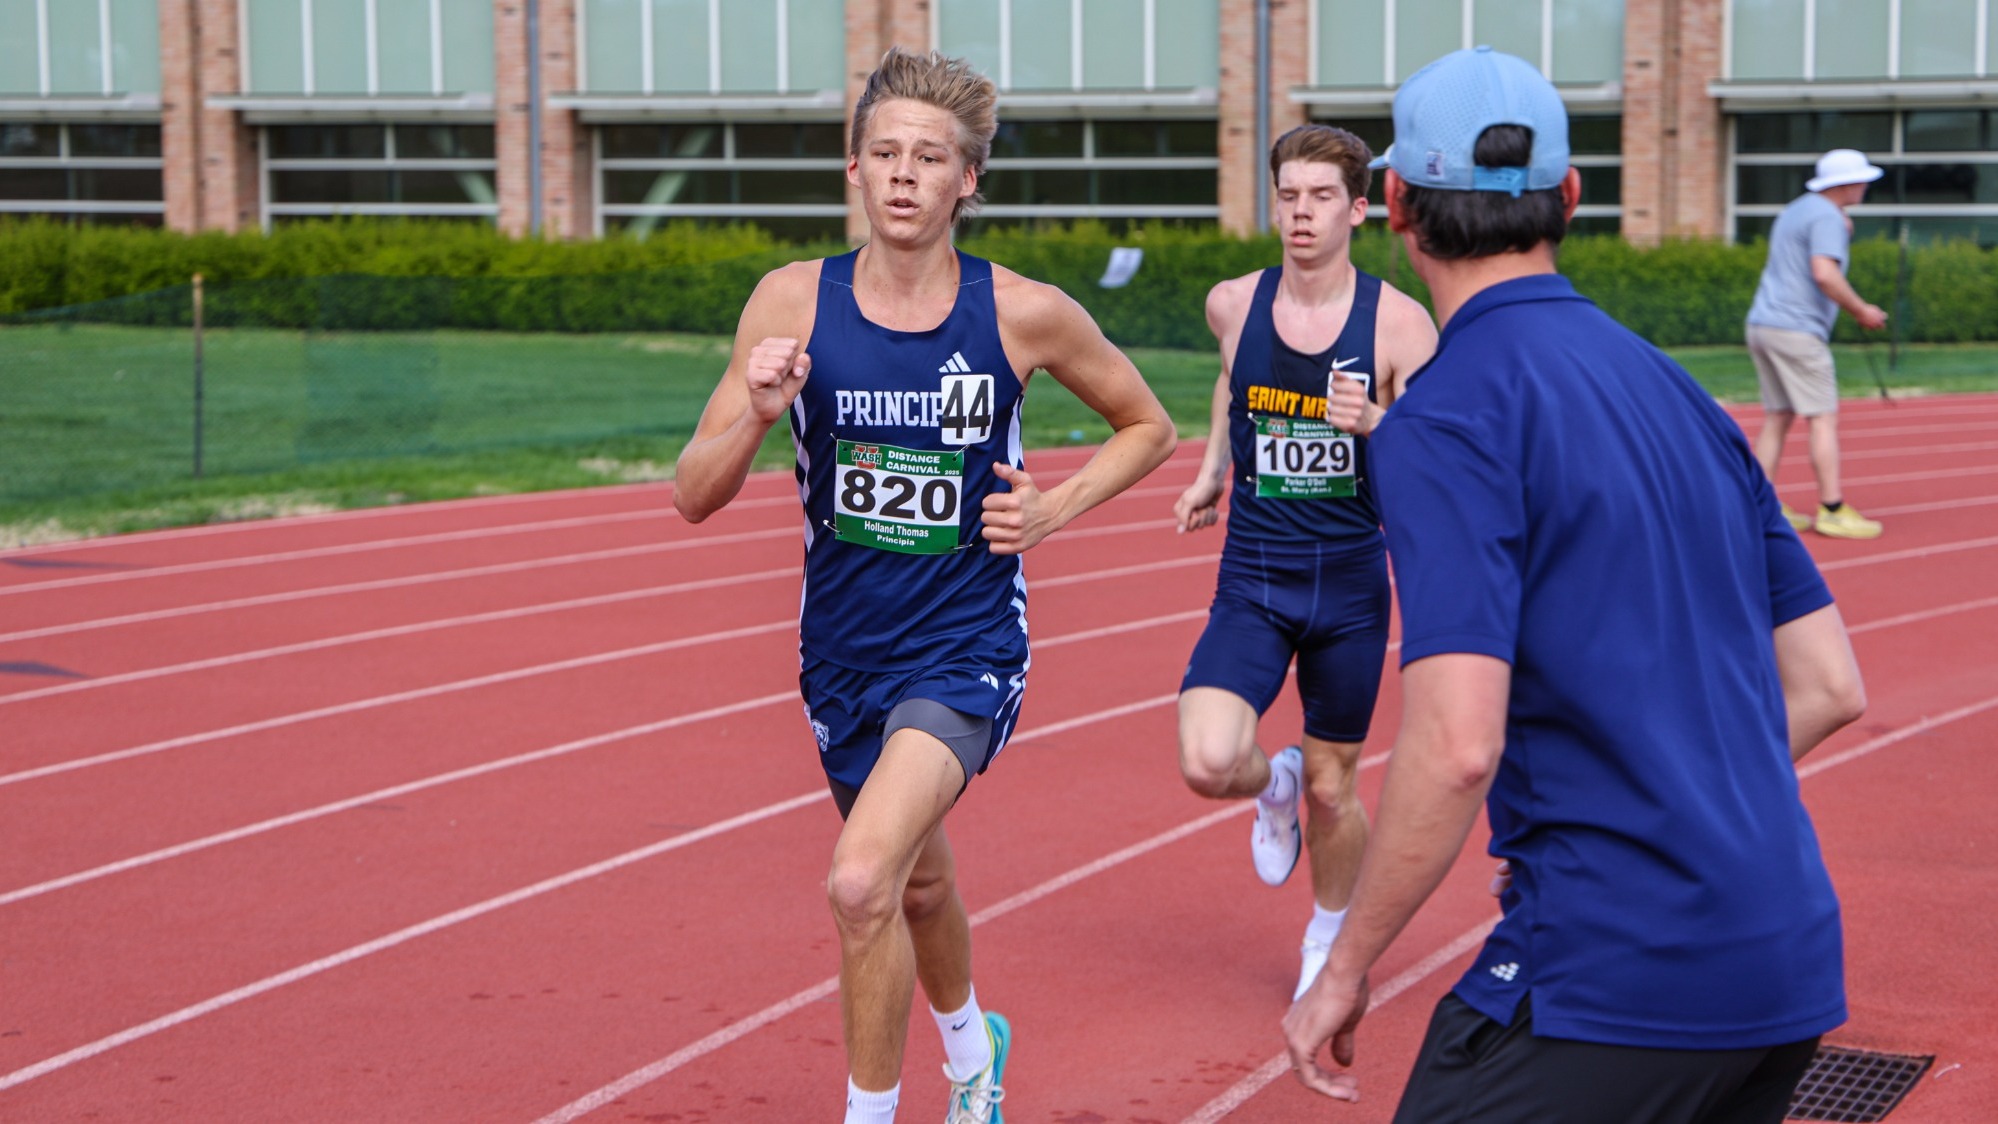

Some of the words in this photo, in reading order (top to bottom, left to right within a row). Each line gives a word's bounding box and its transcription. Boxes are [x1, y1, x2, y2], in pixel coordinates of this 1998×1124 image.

[835, 390, 943, 427] PRINCIP
[942, 379, 991, 439] 44
[1248, 385, 1301, 416] SAINT
[1301, 394, 1328, 418] MA
[1292, 430, 1335, 438] CARNIVAL
[851, 450, 882, 465] WASH
[888, 450, 941, 464] DISTANCE
[1263, 439, 1350, 473] 1029
[886, 461, 940, 474] CARNIVAL
[840, 469, 957, 522] 820
[1291, 486, 1309, 495] Mary
[864, 520, 894, 534] Holland
[897, 525, 929, 538] Thomas
[876, 534, 915, 547] Principia
